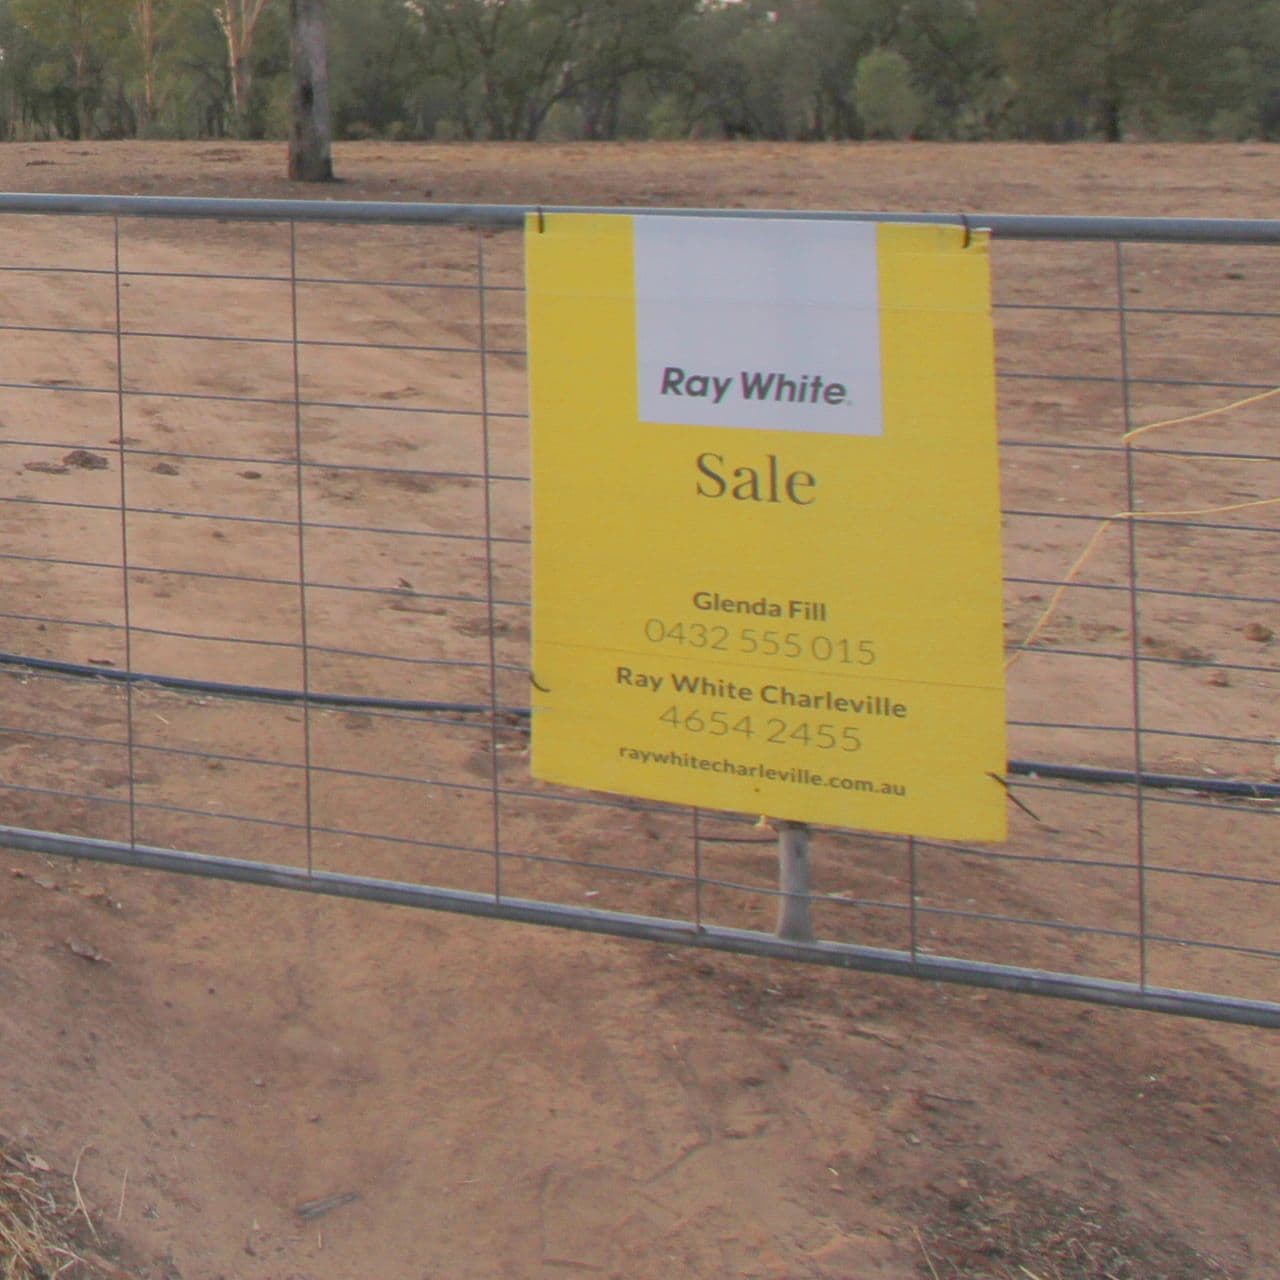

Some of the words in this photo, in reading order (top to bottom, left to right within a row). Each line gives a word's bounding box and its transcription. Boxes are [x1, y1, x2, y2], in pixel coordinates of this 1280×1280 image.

[660, 366, 733, 405] Ray
[740, 371, 846, 405] White
[695, 452, 816, 506] Sale
[692, 591, 782, 619] Glenda
[788, 599, 828, 623] Fill
[644, 618, 728, 652] 0432
[740, 627, 802, 659] 555
[811, 634, 877, 666] 015
[616, 667, 665, 693] Ray
[671, 672, 754, 704] White
[760, 684, 907, 719] Charleville
[658, 705, 755, 741] 4654
[766, 717, 862, 752] 2455
[619, 746, 906, 798] raywhitecharleville.com.au
